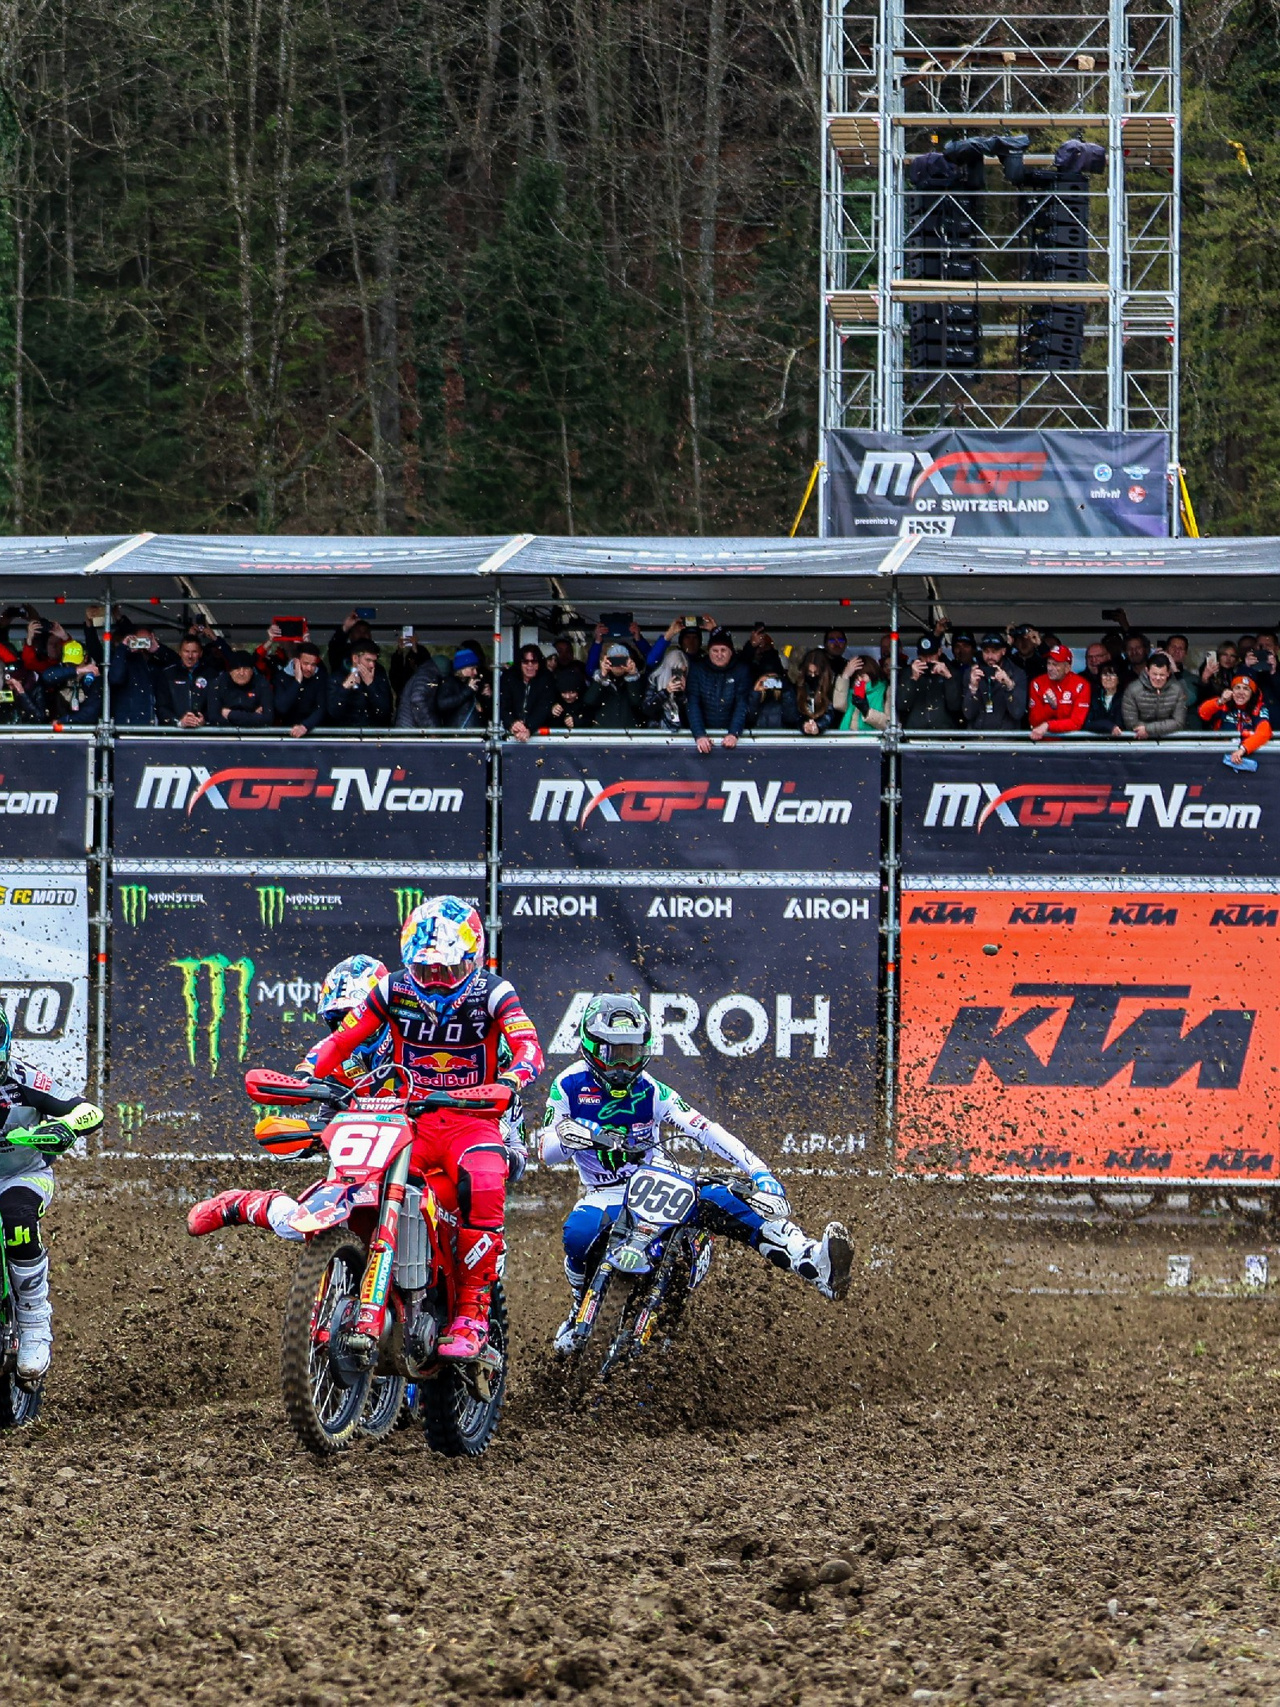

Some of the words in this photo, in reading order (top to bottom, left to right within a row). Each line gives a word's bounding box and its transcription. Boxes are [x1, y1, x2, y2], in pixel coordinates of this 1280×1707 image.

[856, 451, 1048, 501] MXGP
[915, 500, 937, 512] OF
[942, 500, 1049, 513] SWITZERLAND
[854, 517, 887, 527] presented
[889, 517, 898, 527] by
[64, 645, 81, 656] 46
[148, 892, 204, 904] MONSTER
[286, 894, 342, 906] MONSTER
[513, 895, 597, 917] AIROH
[648, 896, 732, 918] AIROH
[783, 897, 869, 920] AIROH
[908, 902, 977, 925] KTM
[1008, 902, 1077, 925] KTM
[1109, 903, 1178, 926] KTM
[1209, 903, 1279, 927] KTM
[927, 983, 1257, 1089] KTM
[410, 1070, 443, 1087] Red
[444, 1071, 478, 1087] Bull
[329, 1124, 402, 1169] 61
[1105, 1146, 1172, 1169] KTM
[1205, 1148, 1274, 1171] KTM
[628, 1175, 693, 1221] 959
